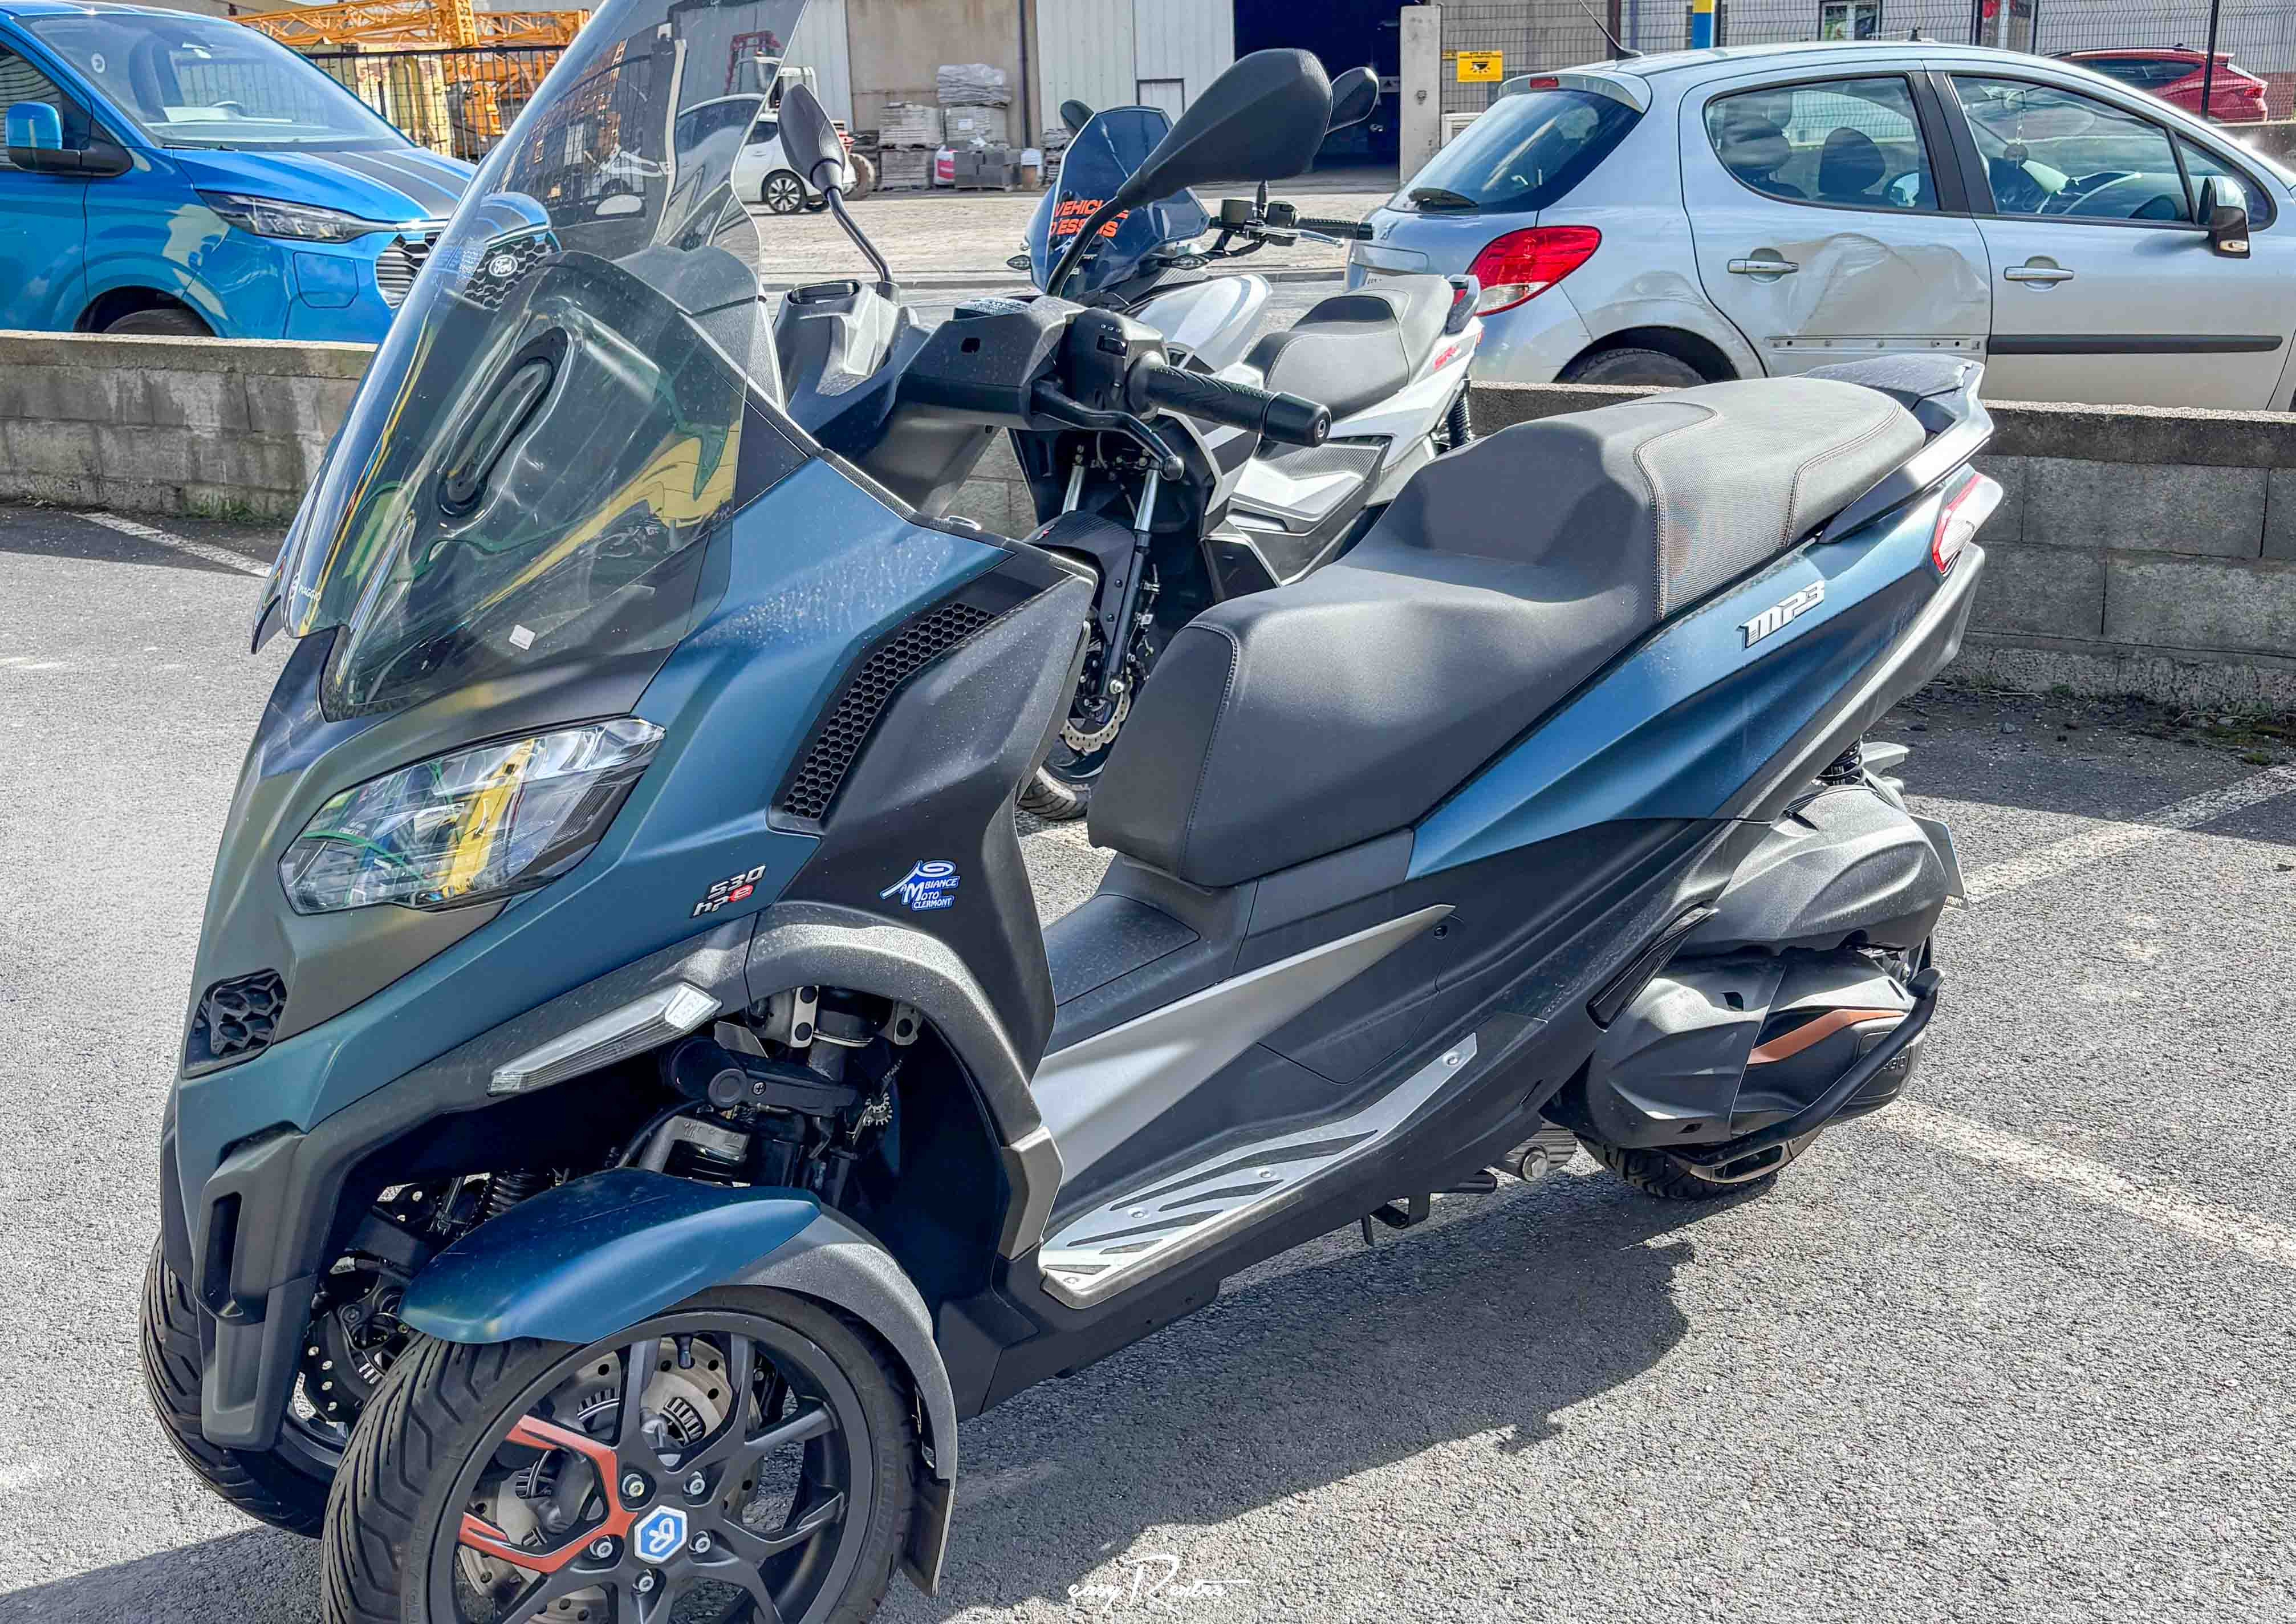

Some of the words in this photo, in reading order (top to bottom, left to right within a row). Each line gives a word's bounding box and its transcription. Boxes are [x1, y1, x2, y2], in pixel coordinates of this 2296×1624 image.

[1737, 579, 1825, 648] MP3
[708, 865, 766, 899] 530
[913, 897, 953, 909] CLERMONT
